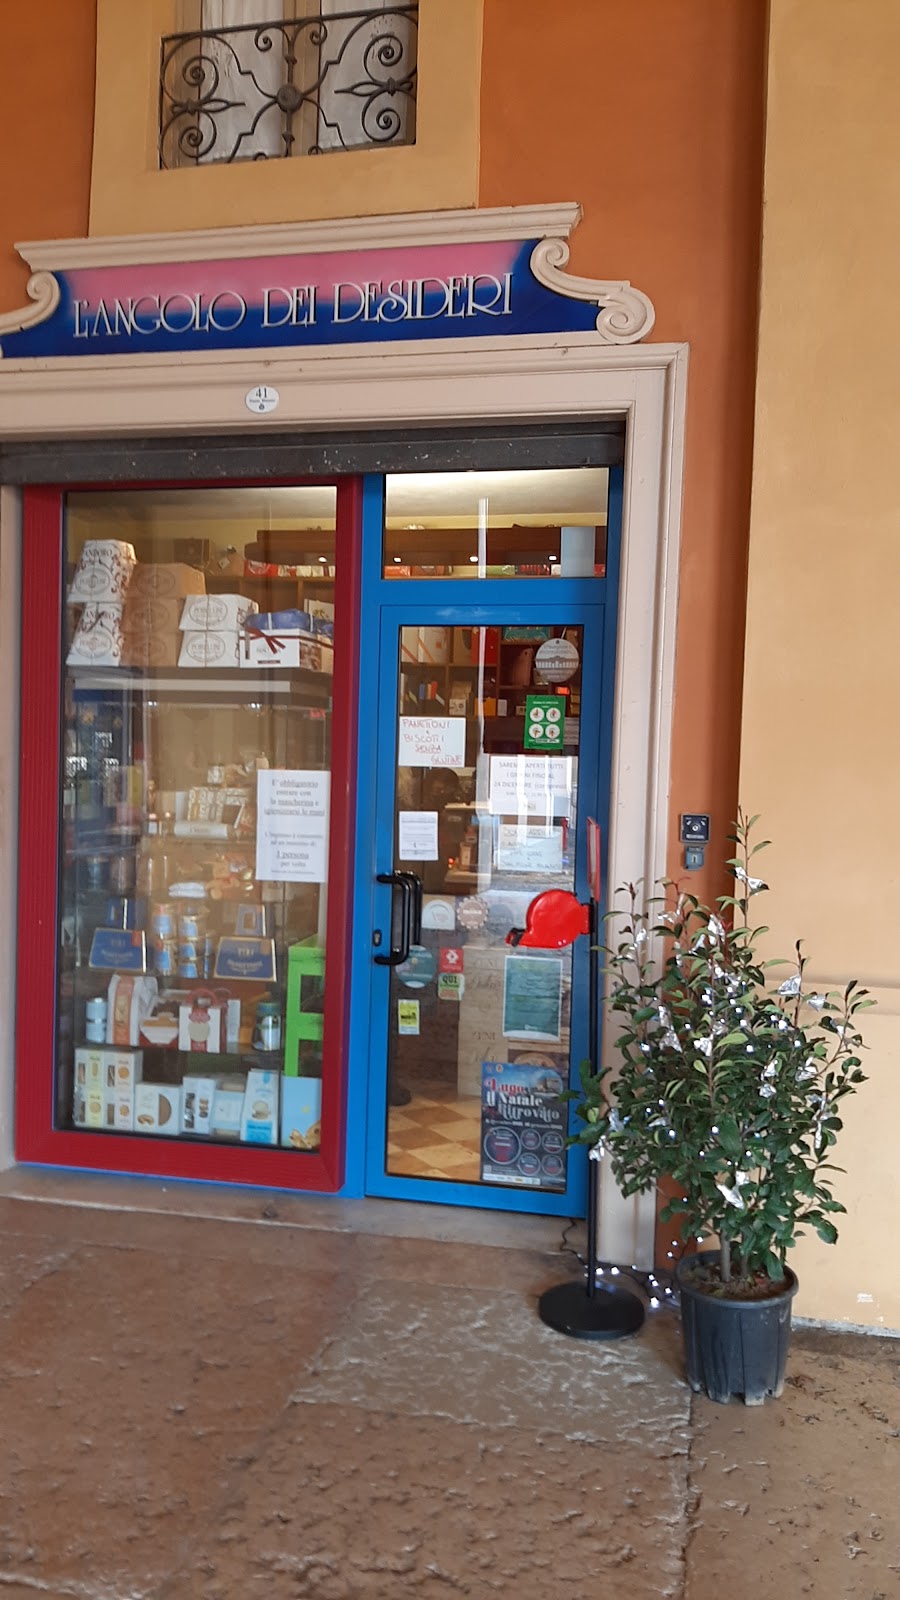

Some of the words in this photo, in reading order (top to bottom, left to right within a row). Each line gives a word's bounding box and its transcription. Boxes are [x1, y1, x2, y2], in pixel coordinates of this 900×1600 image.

[73, 291, 248, 338] L'ANGOLO
[261, 284, 320, 327] DEI
[331, 272, 513, 323] DESIDERI
[255, 387, 267, 398] 41
[403, 734, 444, 743] BISCOTTI
[498, 1092, 544, 1107] Natale
